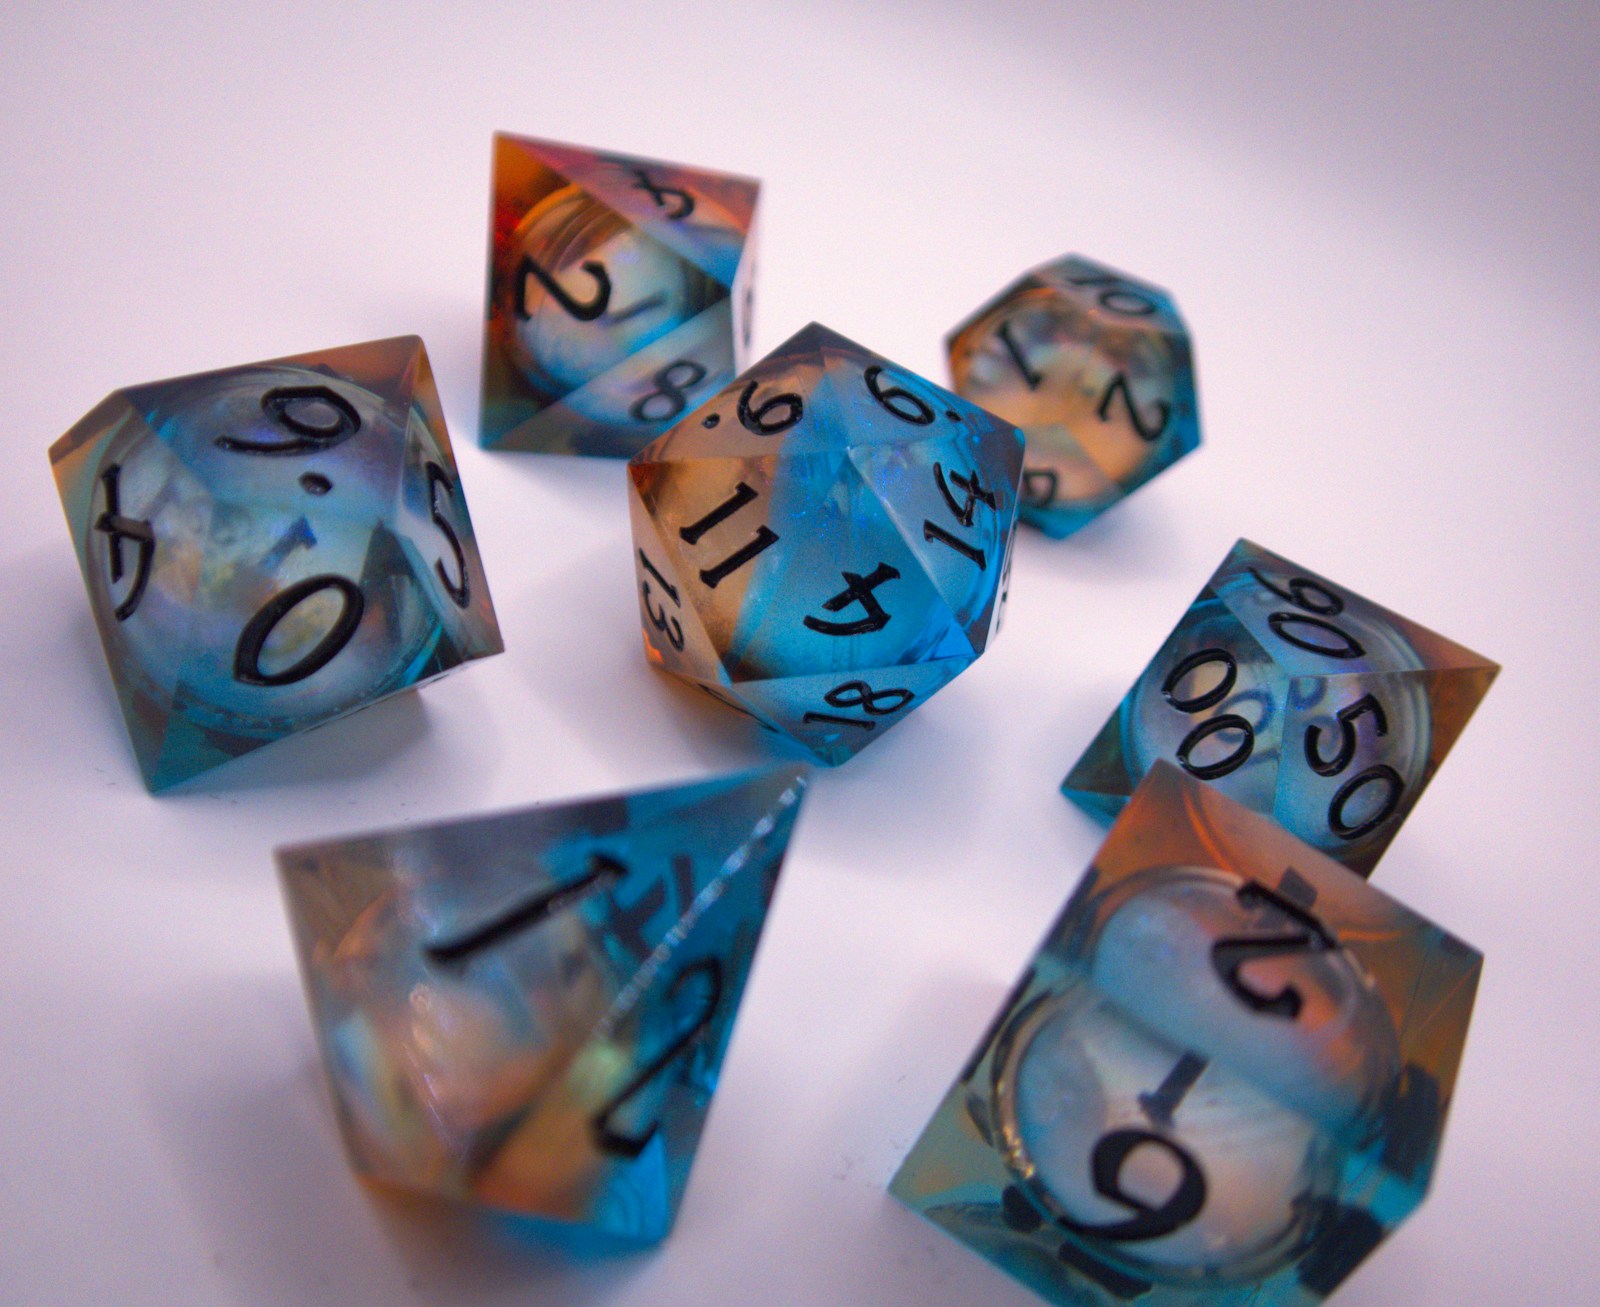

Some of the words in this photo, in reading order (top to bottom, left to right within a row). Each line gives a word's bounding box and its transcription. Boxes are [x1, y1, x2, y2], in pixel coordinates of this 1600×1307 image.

[514, 254, 611, 321] 2
[628, 359, 706, 424] 8
[1098, 372, 1172, 441] 2
[679, 481, 779, 589] 11
[924, 462, 996, 571] 14
[233, 574, 365, 686] 0
[638, 547, 684, 652] 13
[803, 562, 900, 636] 4
[802, 680, 915, 730] 18
[1161, 648, 1255, 780] 00
[1304, 693, 1406, 840] 50
[589, 955, 723, 1159] 2
